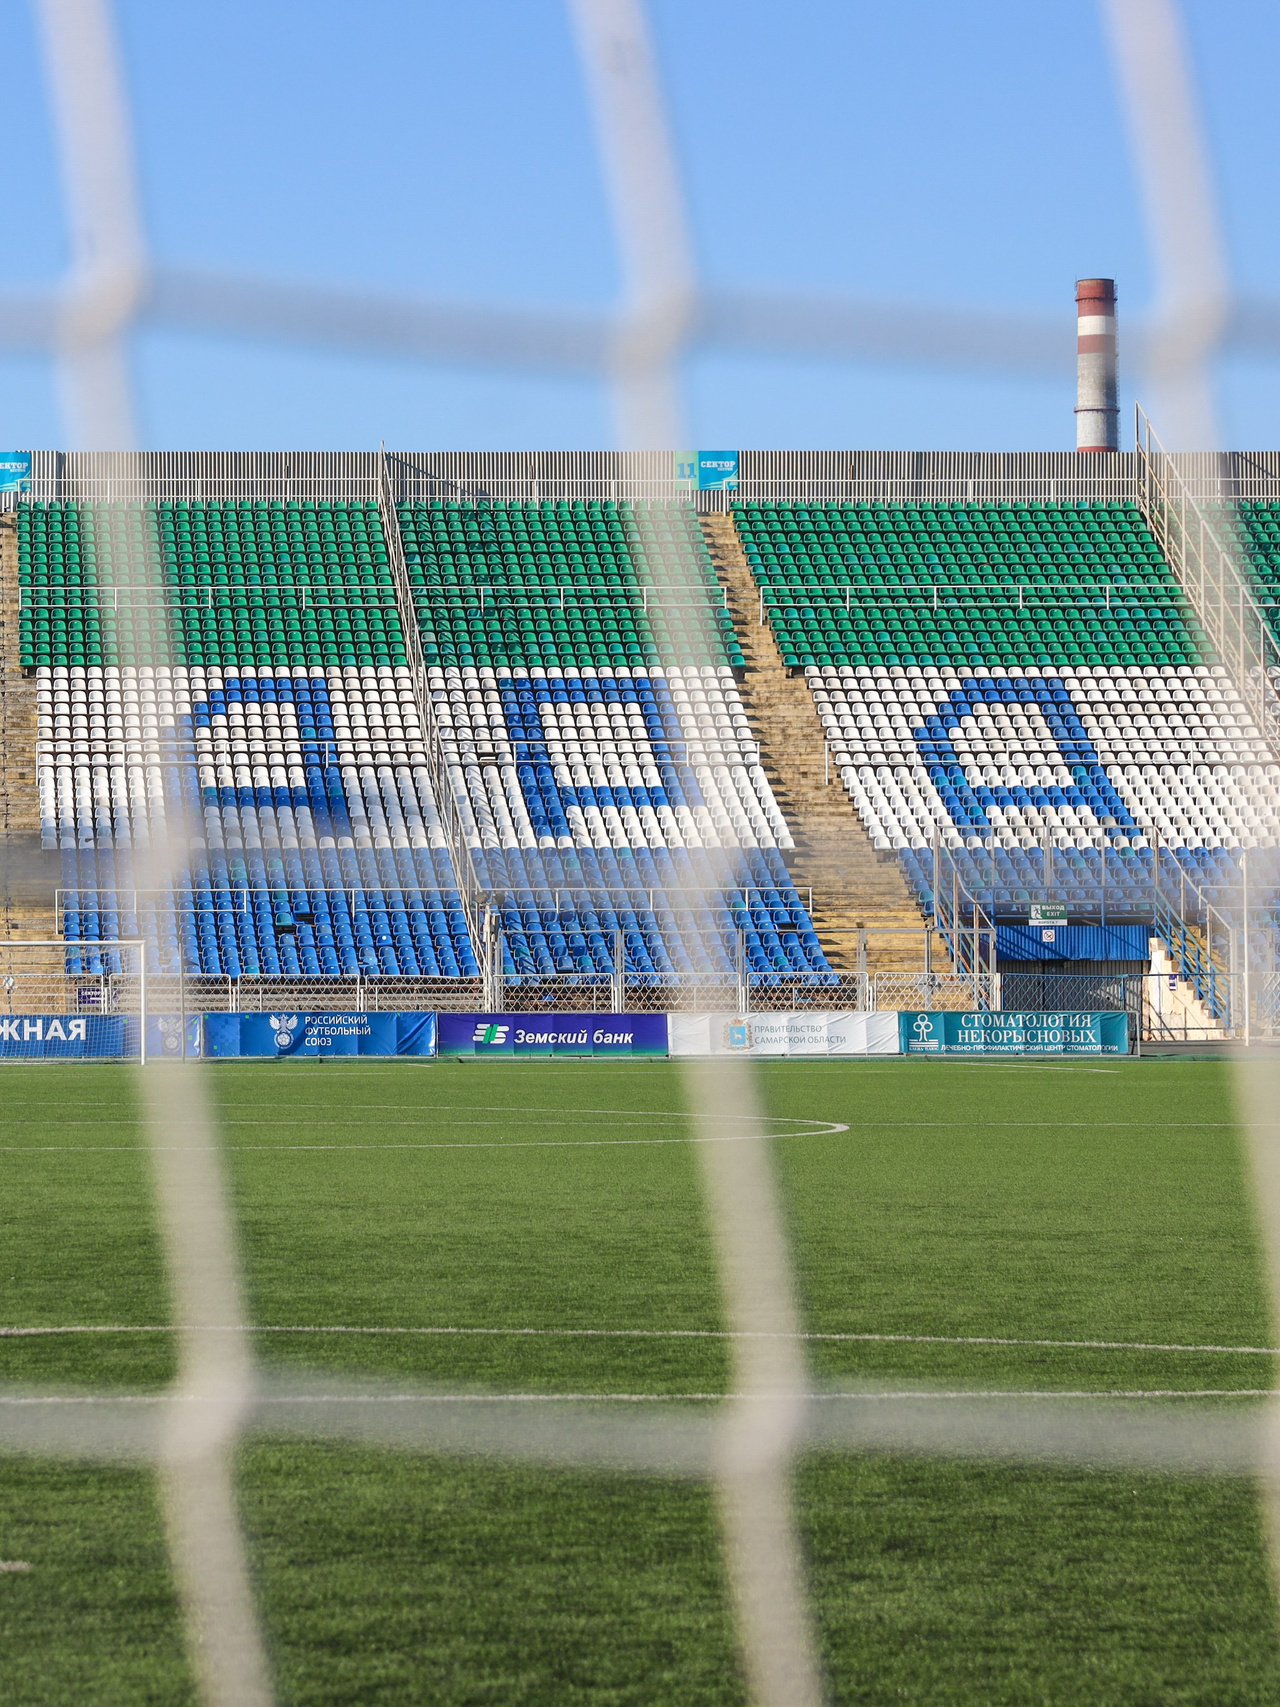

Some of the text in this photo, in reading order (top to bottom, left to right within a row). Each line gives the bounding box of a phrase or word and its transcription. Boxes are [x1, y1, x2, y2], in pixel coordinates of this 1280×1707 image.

[700, 460, 736, 468] СЕКТОР
[677, 462, 697, 479] 11
[304, 1014, 368, 1025] РОССИЙСКИЙ
[961, 1013, 1091, 1028] СТОМАТОЛОГИЯ
[304, 1025, 371, 1036] ФУТБОЛЬНЫЙ
[754, 1025, 822, 1034] ПРАВИТЕЛЬСТВО
[304, 1037, 332, 1046] СОЮЗ
[514, 1028, 633, 1044] Земский банк
[754, 1035, 847, 1044] САМАРСКОЙ ОБЛАСТИ
[957, 1029, 1097, 1043] НЕКОРЫСНОВЫХ
